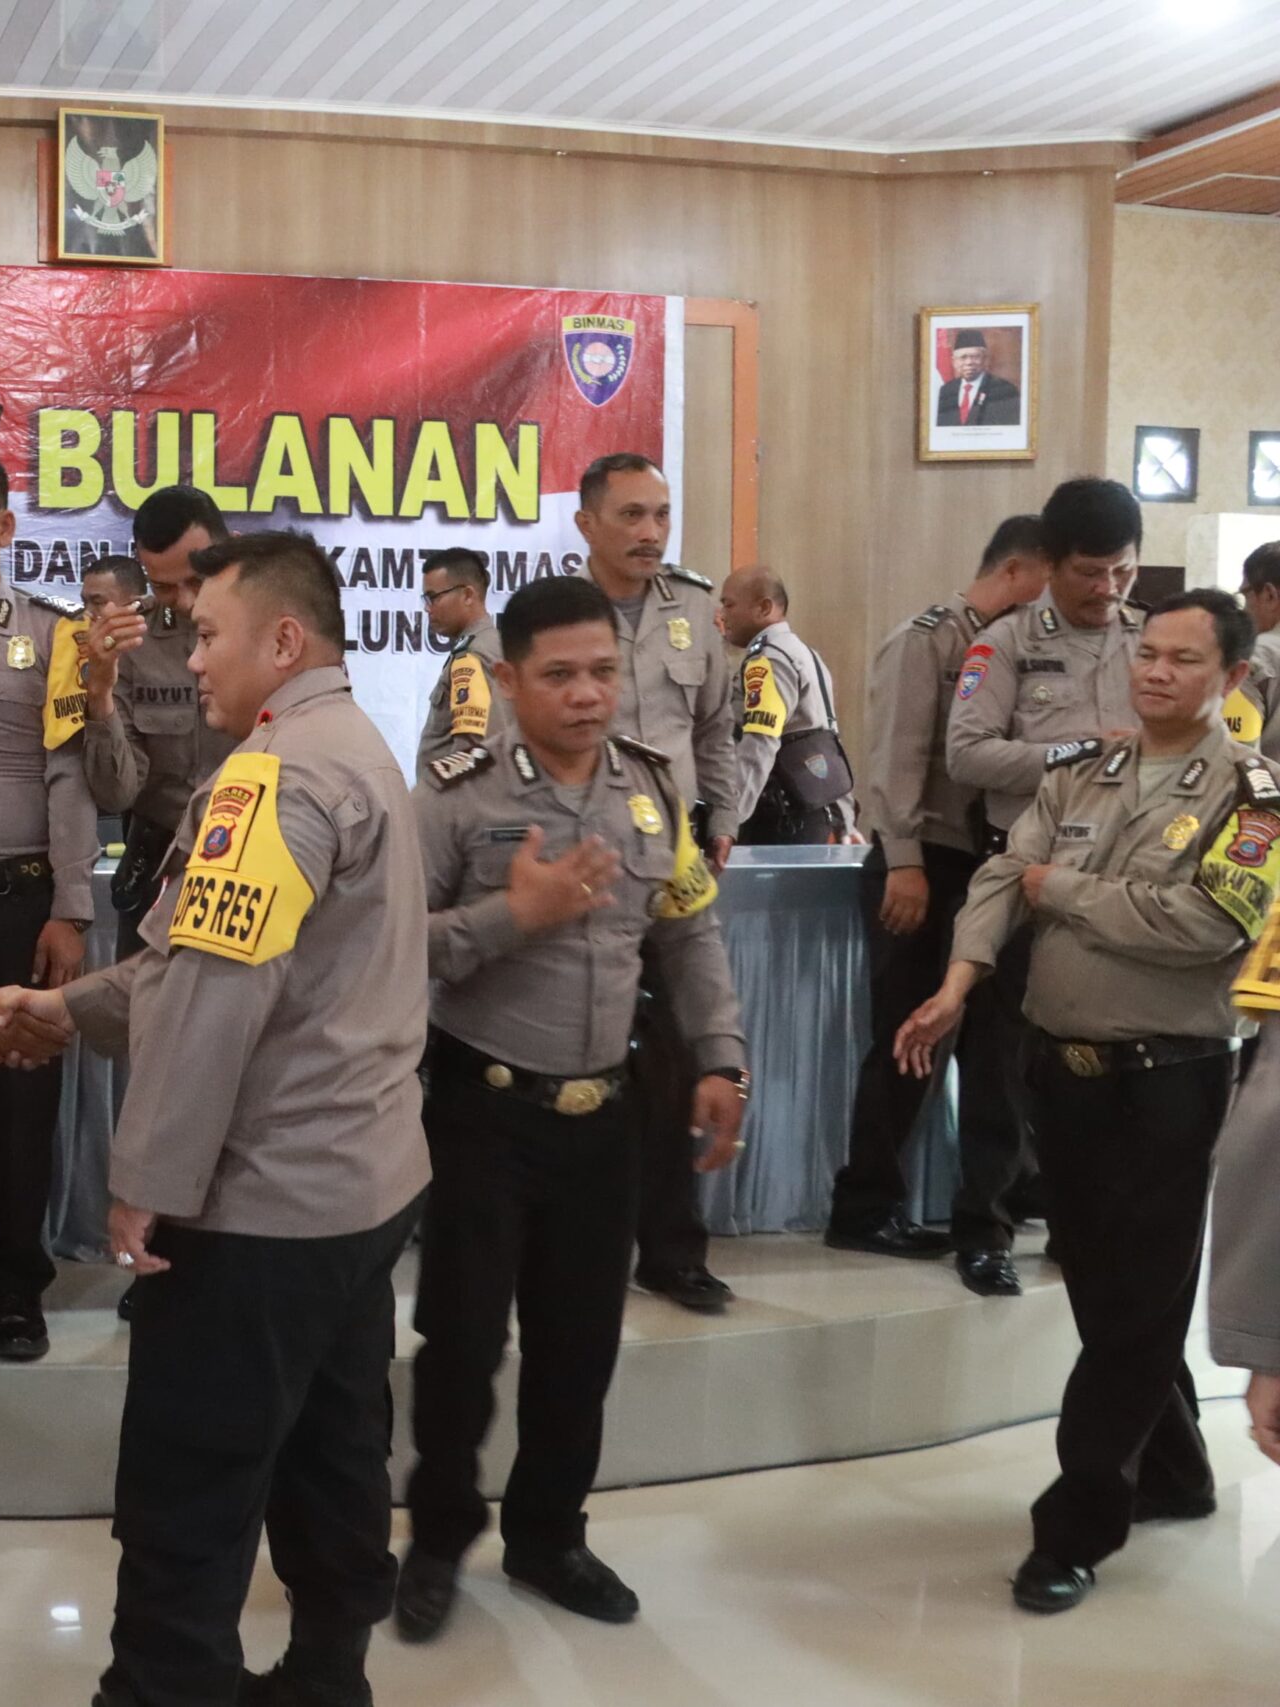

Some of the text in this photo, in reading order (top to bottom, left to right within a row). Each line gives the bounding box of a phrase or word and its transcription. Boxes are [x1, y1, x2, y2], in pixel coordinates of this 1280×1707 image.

[573, 316, 625, 331] BINMAS
[38, 409, 539, 521] BULANAN
[210, 880, 262, 942] RES
